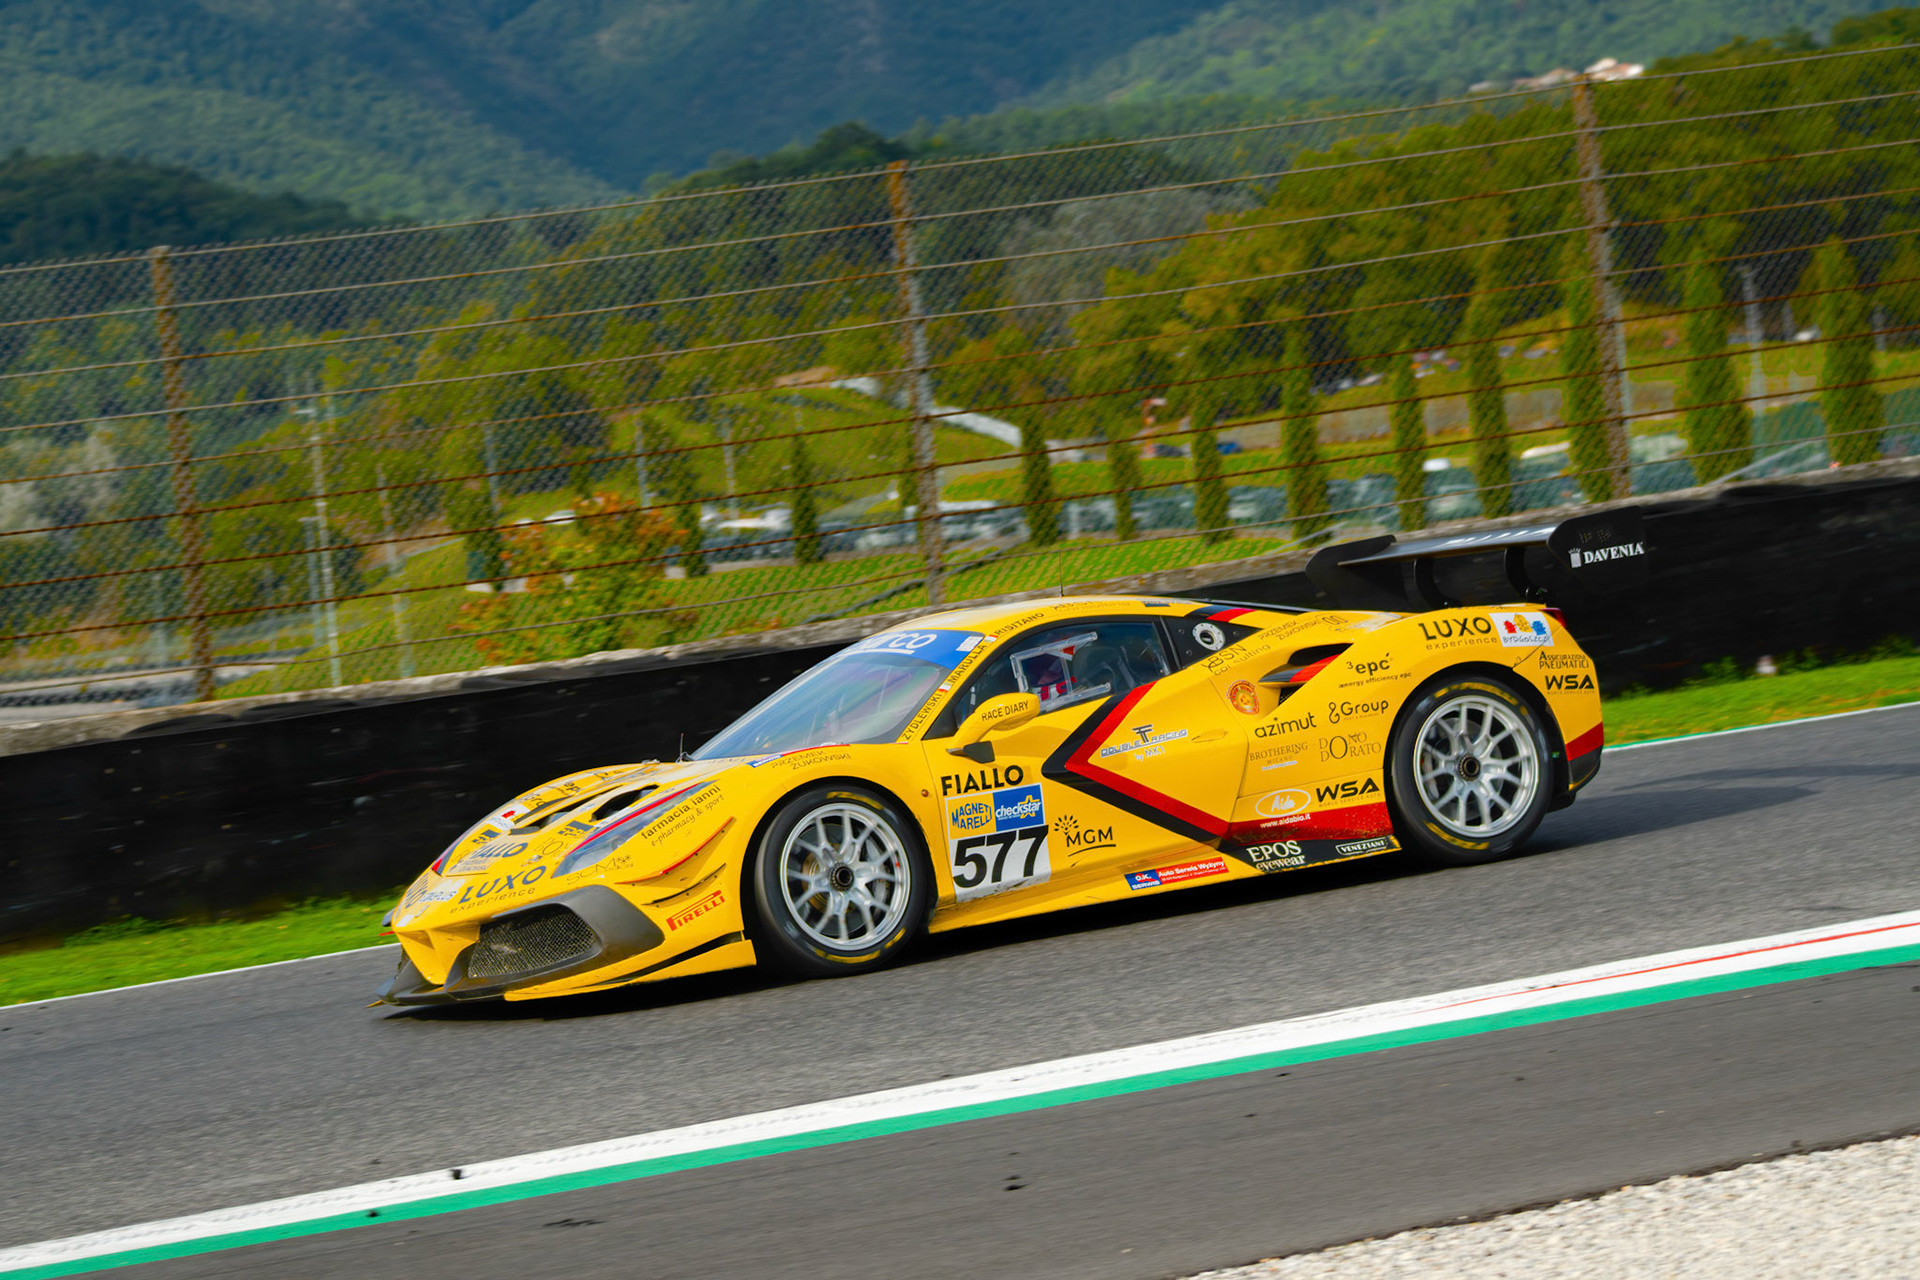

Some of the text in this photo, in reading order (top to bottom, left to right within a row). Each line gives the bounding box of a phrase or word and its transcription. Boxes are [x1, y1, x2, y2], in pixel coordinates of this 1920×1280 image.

[1583, 542, 1645, 565] DAVENIA
[994, 612, 1045, 636] RISITANO
[1418, 616, 1492, 641] LUXO
[1426, 636, 1498, 651] experience
[948, 644, 987, 686] MARULLA
[1539, 660, 1589, 670] PNEUMATICI
[1366, 673, 1399, 685] efficiency
[1400, 671, 1412, 681] epc
[1545, 674, 1595, 691] WSA
[901, 693, 943, 741] ZYDLEWSKI
[981, 700, 1029, 722] RACE DIARY
[1254, 711, 1317, 739] azimut
[1101, 729, 1188, 758] DOUBLE RACING
[1249, 741, 1309, 762] BROTHERING
[771, 750, 825, 768] PRZEMEK
[940, 764, 1024, 796] FIALLO
[1315, 777, 1380, 803] WSA
[641, 784, 722, 840] farmacia ianni
[651, 813, 697, 847] e-pharmacy
[704, 793, 725, 812] sport
[995, 801, 1042, 818] checkstar
[1259, 812, 1312, 829] www.aidabio.it
[1066, 825, 1114, 848] MGM
[1340, 839, 1386, 854] VENEZIANI
[952, 825, 1049, 889] 577
[1246, 839, 1303, 863] EPOS
[1158, 870, 1175, 878] Auto
[1175, 865, 1198, 875] Serwis
[1255, 853, 1306, 873] eyewear
[458, 865, 547, 905] LUXO
[1135, 872, 1152, 882] O.K.
[450, 886, 537, 914] experience
[666, 889, 726, 932] PIRELLI
